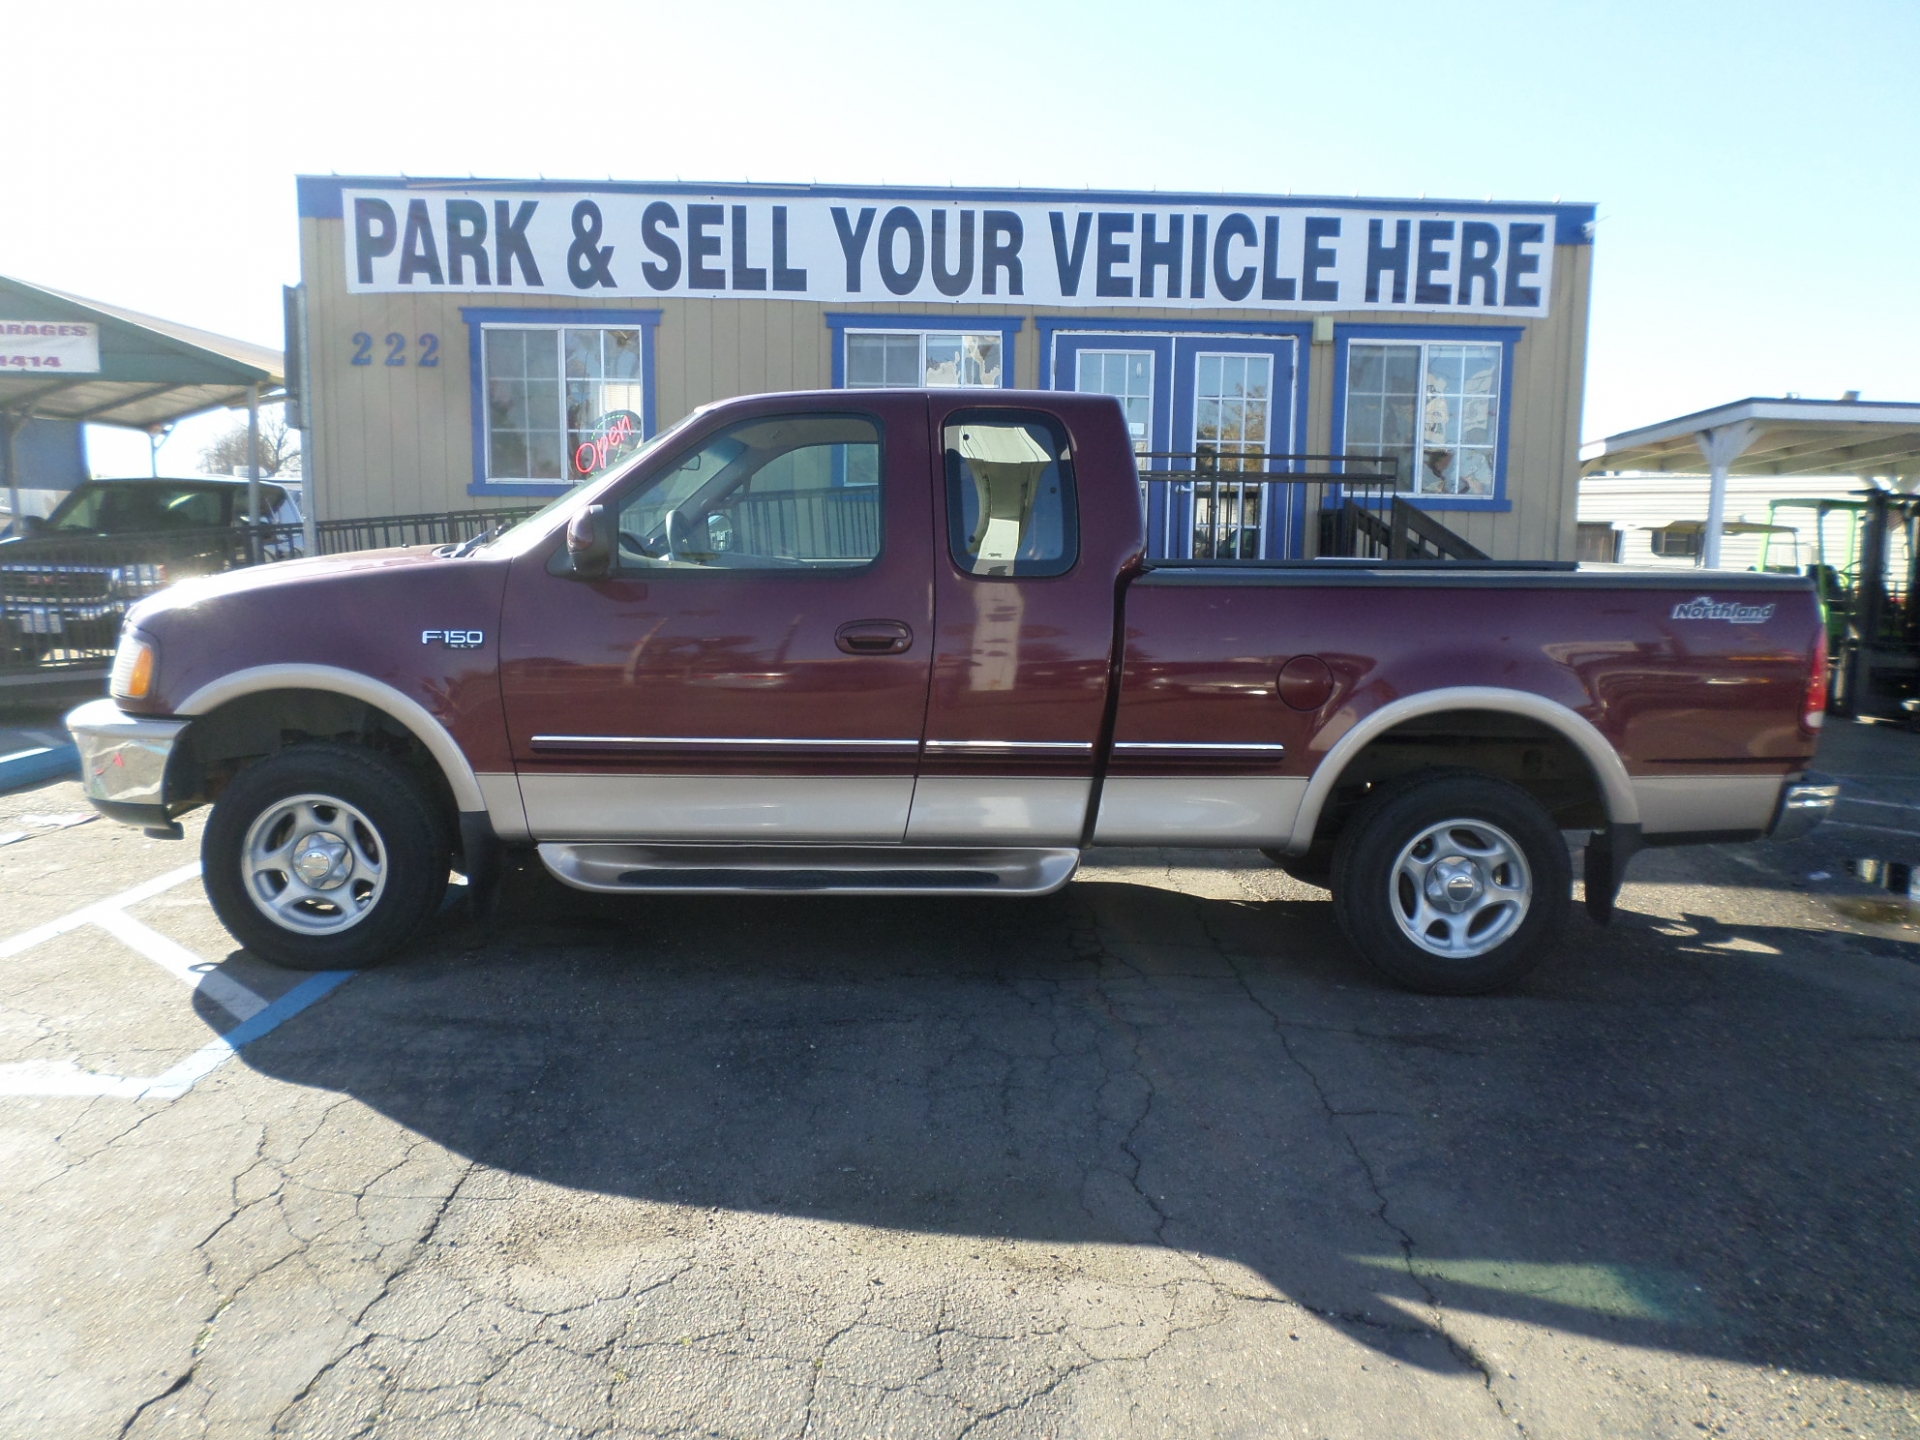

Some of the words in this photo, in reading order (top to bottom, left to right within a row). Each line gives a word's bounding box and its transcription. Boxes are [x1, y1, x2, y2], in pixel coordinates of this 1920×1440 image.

[354, 198, 544, 287] PARK
[567, 199, 618, 290] &
[641, 201, 808, 291] SELL
[830, 206, 1024, 297] YOUR
[1048, 211, 1342, 302] VEHICLE
[1364, 218, 1545, 307] HERE
[350, 331, 439, 367] 222
[575, 414, 632, 474] Open
[1672, 603, 1775, 619] Northland
